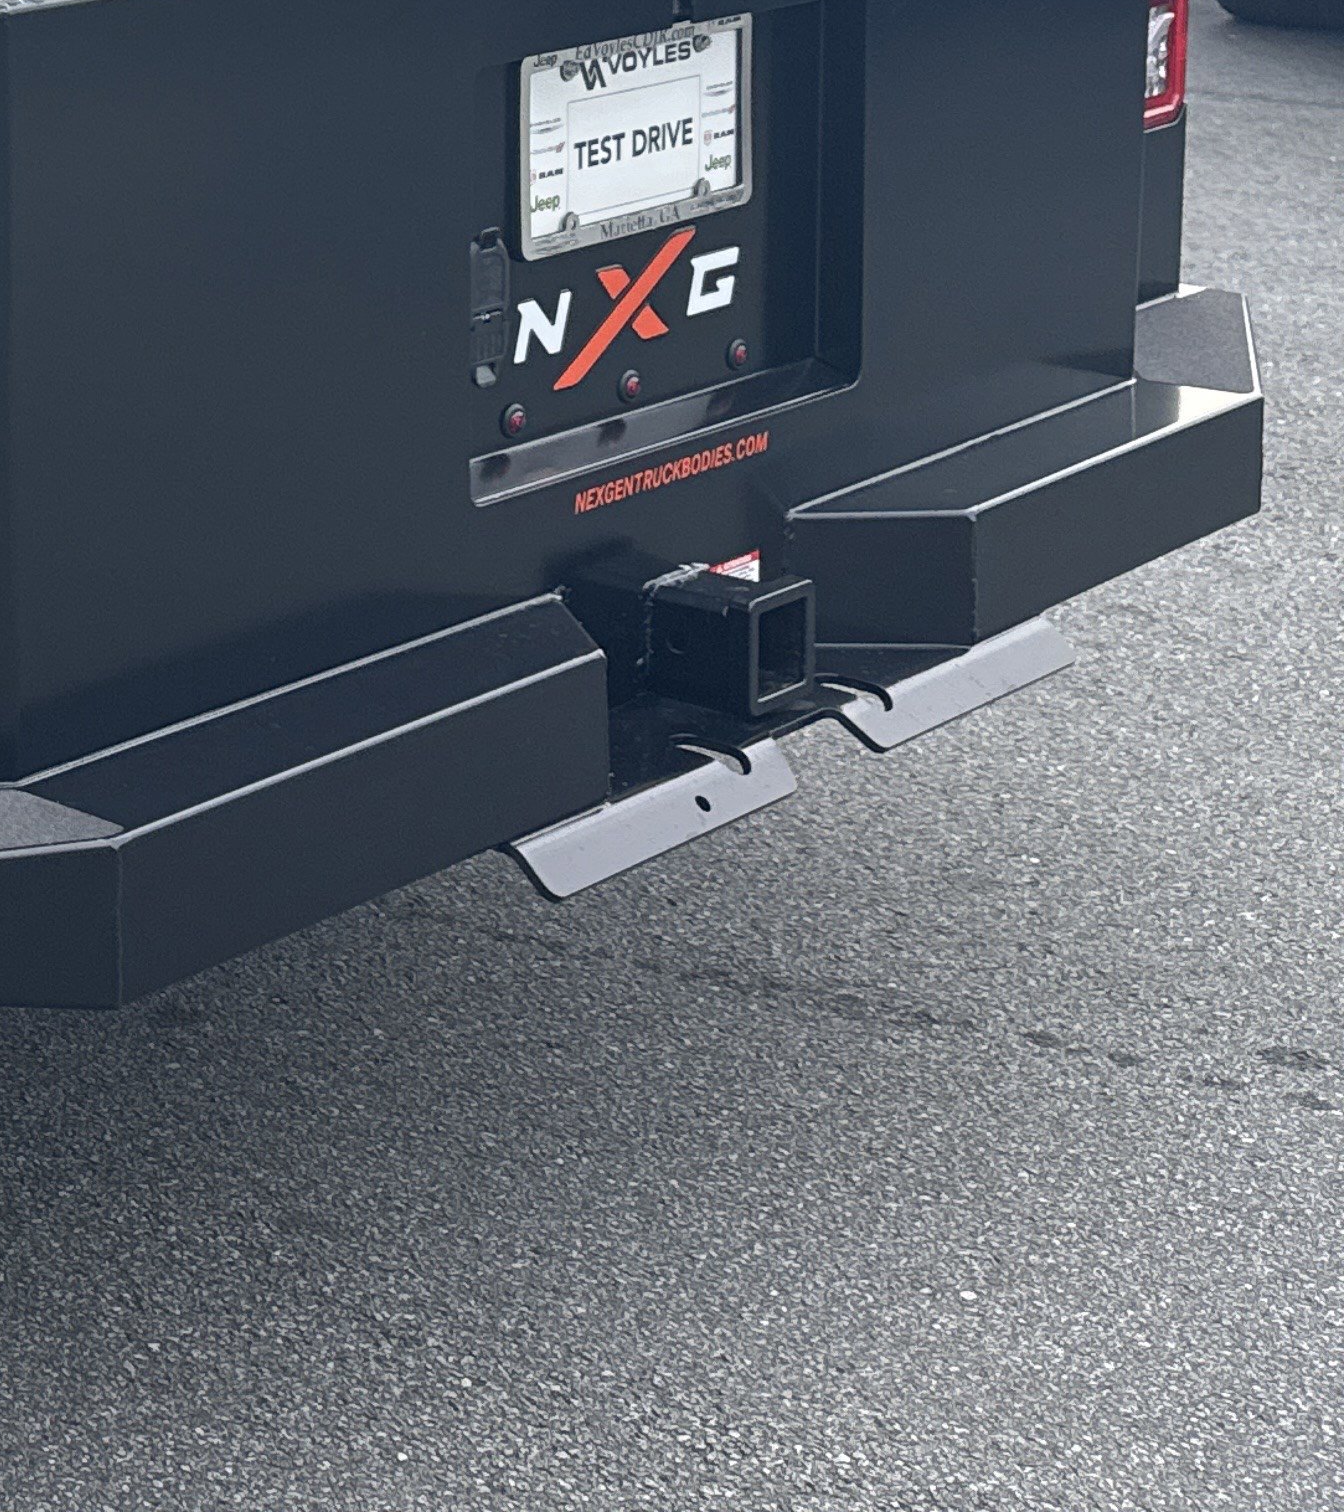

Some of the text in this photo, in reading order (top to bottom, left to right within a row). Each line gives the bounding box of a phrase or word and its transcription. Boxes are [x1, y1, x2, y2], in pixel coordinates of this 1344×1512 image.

[533, 54, 558, 68] Jeep
[608, 40, 691, 75] VOYLES
[574, 117, 693, 170] TEST DRIVE
[705, 154, 732, 172] Jeep
[530, 194, 560, 212] Jeep
[574, 430, 769, 515] NEXGENTRUCKBODIES.COM
